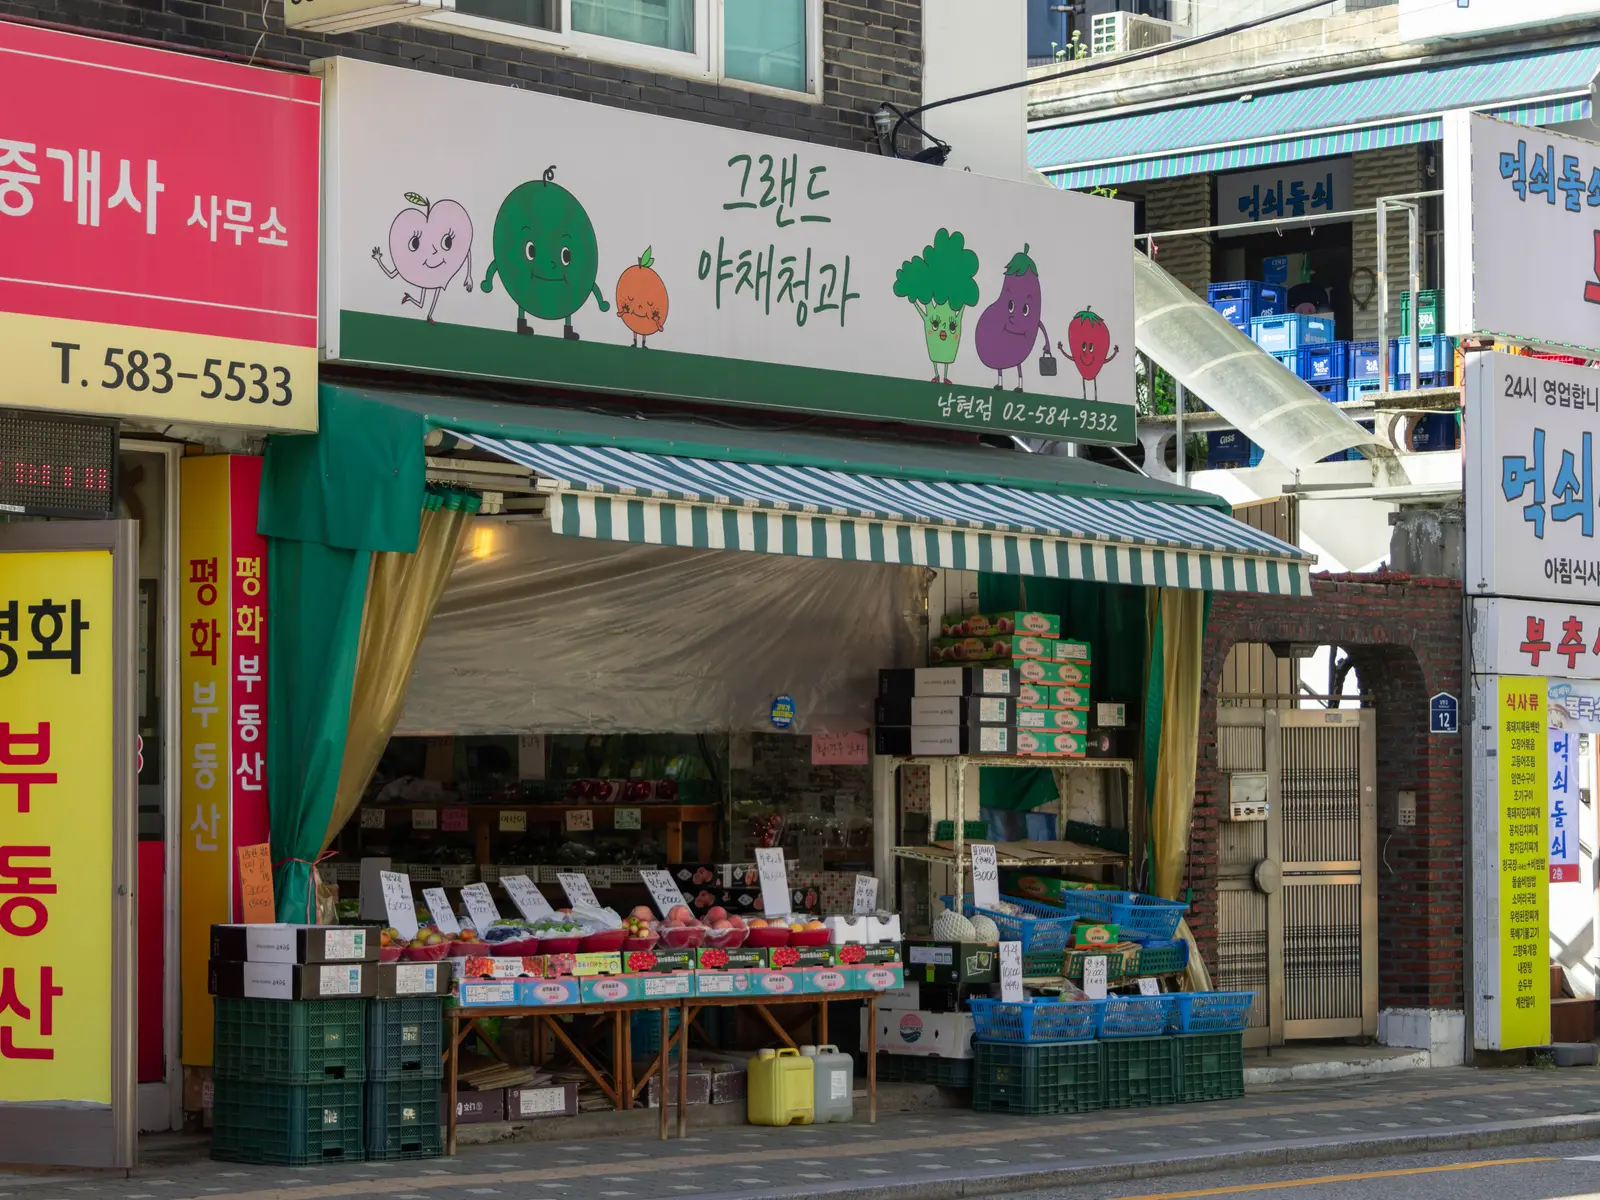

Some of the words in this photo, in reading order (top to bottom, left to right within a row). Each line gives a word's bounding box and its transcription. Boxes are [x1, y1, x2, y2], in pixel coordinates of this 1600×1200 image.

[722, 153, 832, 228] 그랜드
[1238, 173, 1334, 219] 먹쇠돌쇠
[187, 194, 289, 247] 사무소
[697, 236, 861, 328] 야채청과
[50, 341, 89, 388] T.
[101, 346, 293, 407] 583-5533
[1504, 374, 1537, 402] 24시
[937, 393, 993, 421] 남현점
[1002, 401, 1118, 432] 02-584-9332
[189, 556, 221, 666] 평화
[236, 556, 264, 644] 평화
[1520, 615, 1600, 669] 부추
[1506, 693, 1539, 711] 식사류
[236, 654, 265, 791] 부동산
[1438, 712, 1450, 728] 12
[1511, 738, 1535, 751] 오징어볶음
[190, 681, 221, 851] 부동산
[1511, 755, 1536, 768] 고등어조림
[1511, 772, 1536, 785] 임연수구이
[1513, 789, 1534, 802] 조기구이
[1551, 733, 1569, 859] 먹쇠돌쇠
[1509, 841, 1539, 854] 참치김치찌개
[1512, 875, 1537, 889] 돌솥비빔밥
[1552, 867, 1563, 881] 2층
[1512, 892, 1537, 905] 소머리국밥
[1510, 909, 1539, 923] 우렁된장찌개
[1517, 961, 1533, 974] 내장탕
[1517, 979, 1533, 992] 순두부
